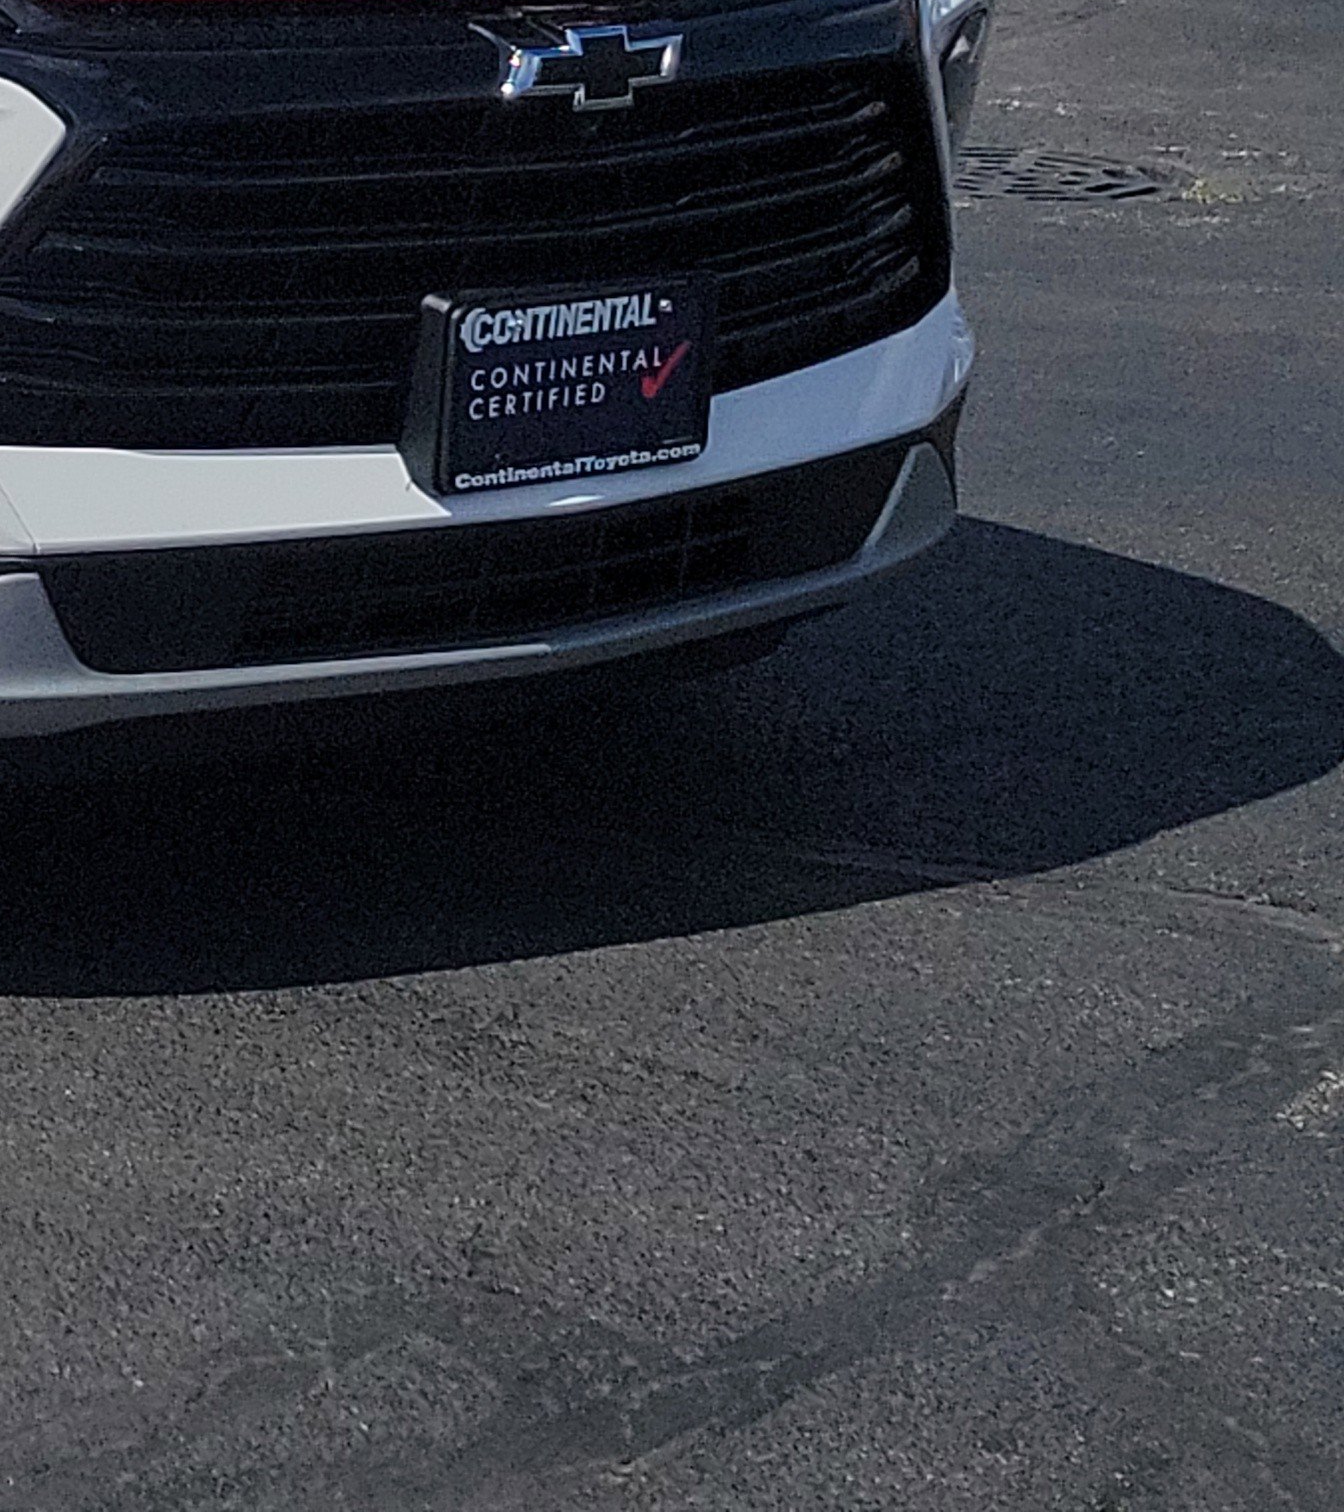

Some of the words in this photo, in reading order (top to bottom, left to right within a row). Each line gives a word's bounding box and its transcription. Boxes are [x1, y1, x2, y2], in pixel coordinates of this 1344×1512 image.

[461, 293, 656, 353] CONTINENTAL
[470, 345, 662, 391] CONTINENTAL
[468, 381, 606, 421] CERTIFIED
[454, 442, 701, 489] ContinentalToyota.com
